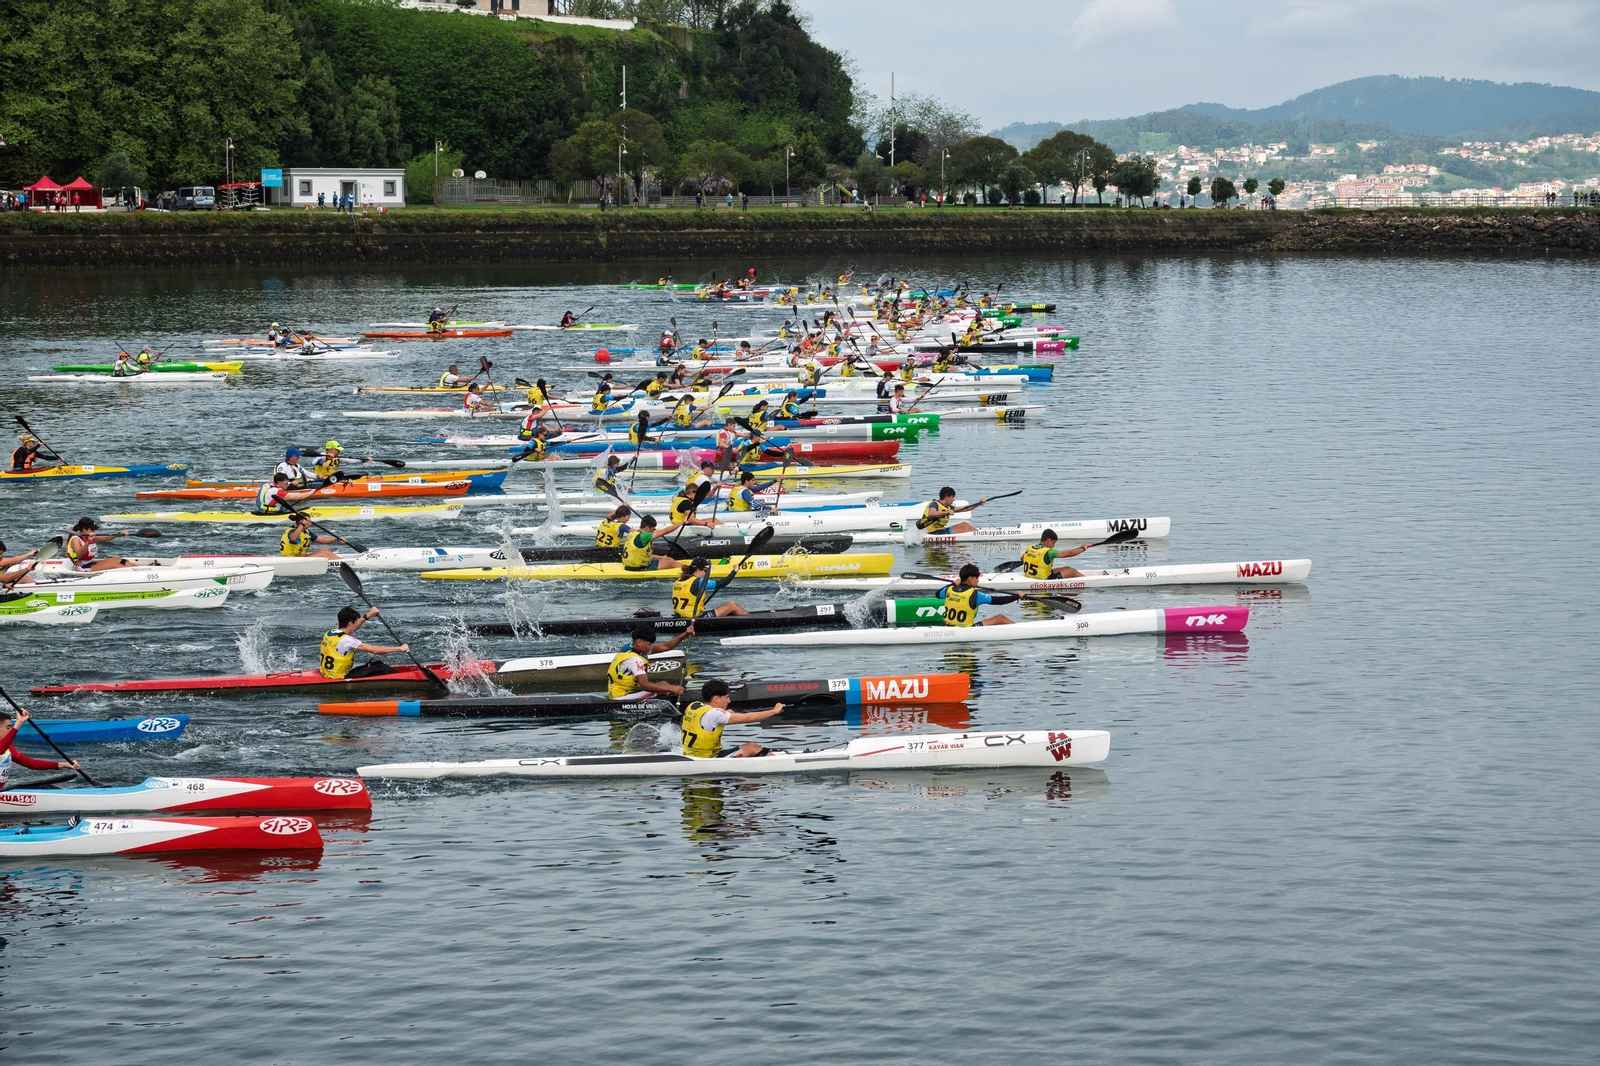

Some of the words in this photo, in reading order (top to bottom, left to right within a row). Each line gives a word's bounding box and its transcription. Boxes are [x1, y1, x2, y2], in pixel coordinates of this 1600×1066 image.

[1004, 409, 1026, 418] FENN
[1108, 518, 1147, 532] MAZU
[973, 528, 1021, 536] eliokayaks.com
[700, 539, 731, 547] FUSION
[1238, 561, 1282, 578] MAZU
[1030, 580, 1085, 589] eliokayaks.com
[1076, 621, 1089, 630] 300
[766, 683, 796, 691] KAYAK
[798, 682, 819, 690] VIGO
[831, 680, 847, 688] 379
[867, 678, 929, 701] MAZU
[984, 733, 1026, 747] CX
[908, 742, 924, 750] 377
[518, 758, 560, 766] CX
[186, 782, 205, 791] 468
[315, 779, 360, 794] SIPRE
[94, 822, 113, 831] 474
[261, 818, 309, 832] SIPRE
